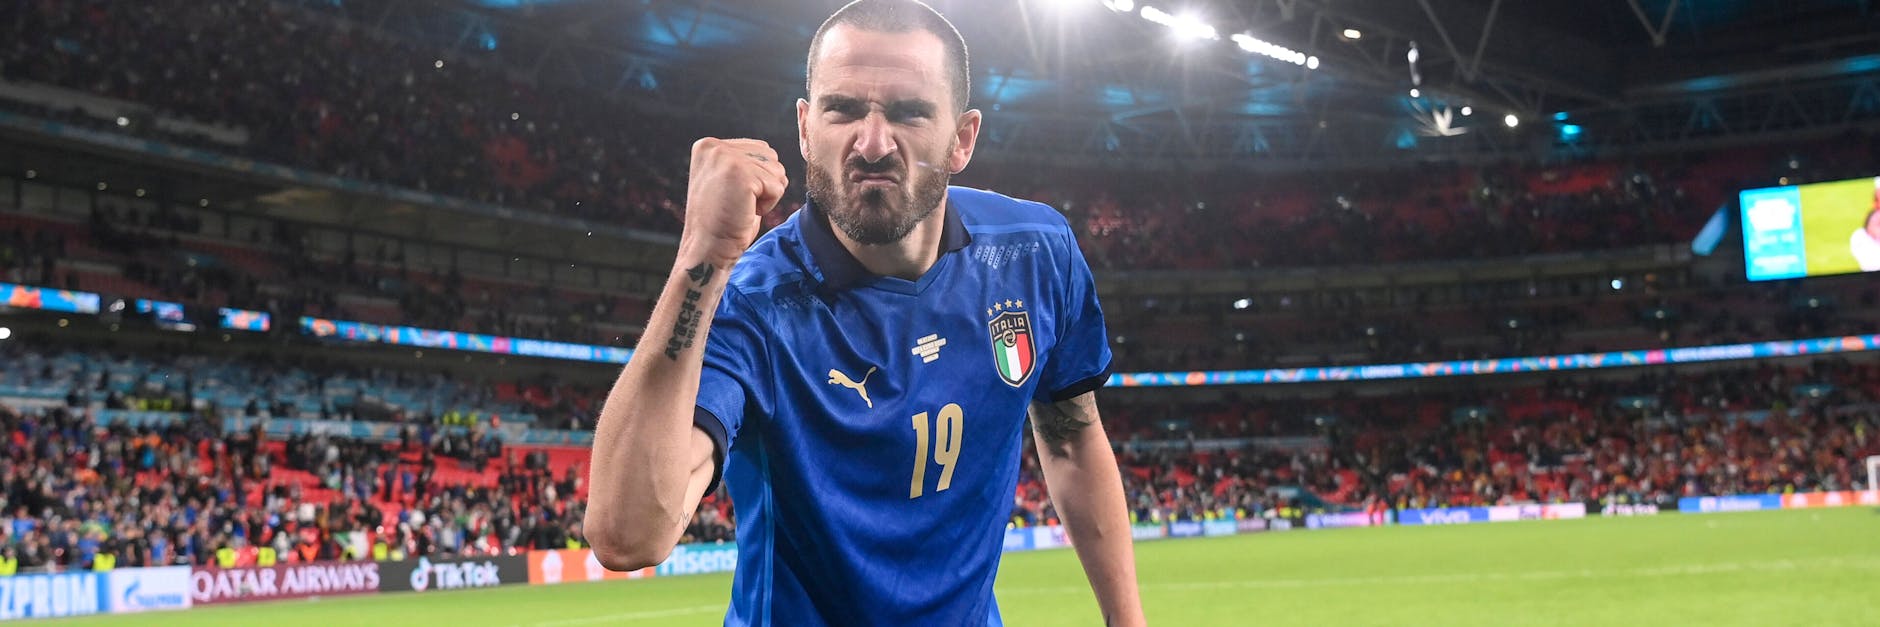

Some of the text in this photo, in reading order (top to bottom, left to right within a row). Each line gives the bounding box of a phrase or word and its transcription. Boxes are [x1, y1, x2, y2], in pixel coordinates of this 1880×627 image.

[992, 317, 1025, 336] ITALIA
[909, 403, 964, 499] 19
[191, 562, 380, 602] QATAR AIRWAYS
[433, 561, 500, 589] TikTok
